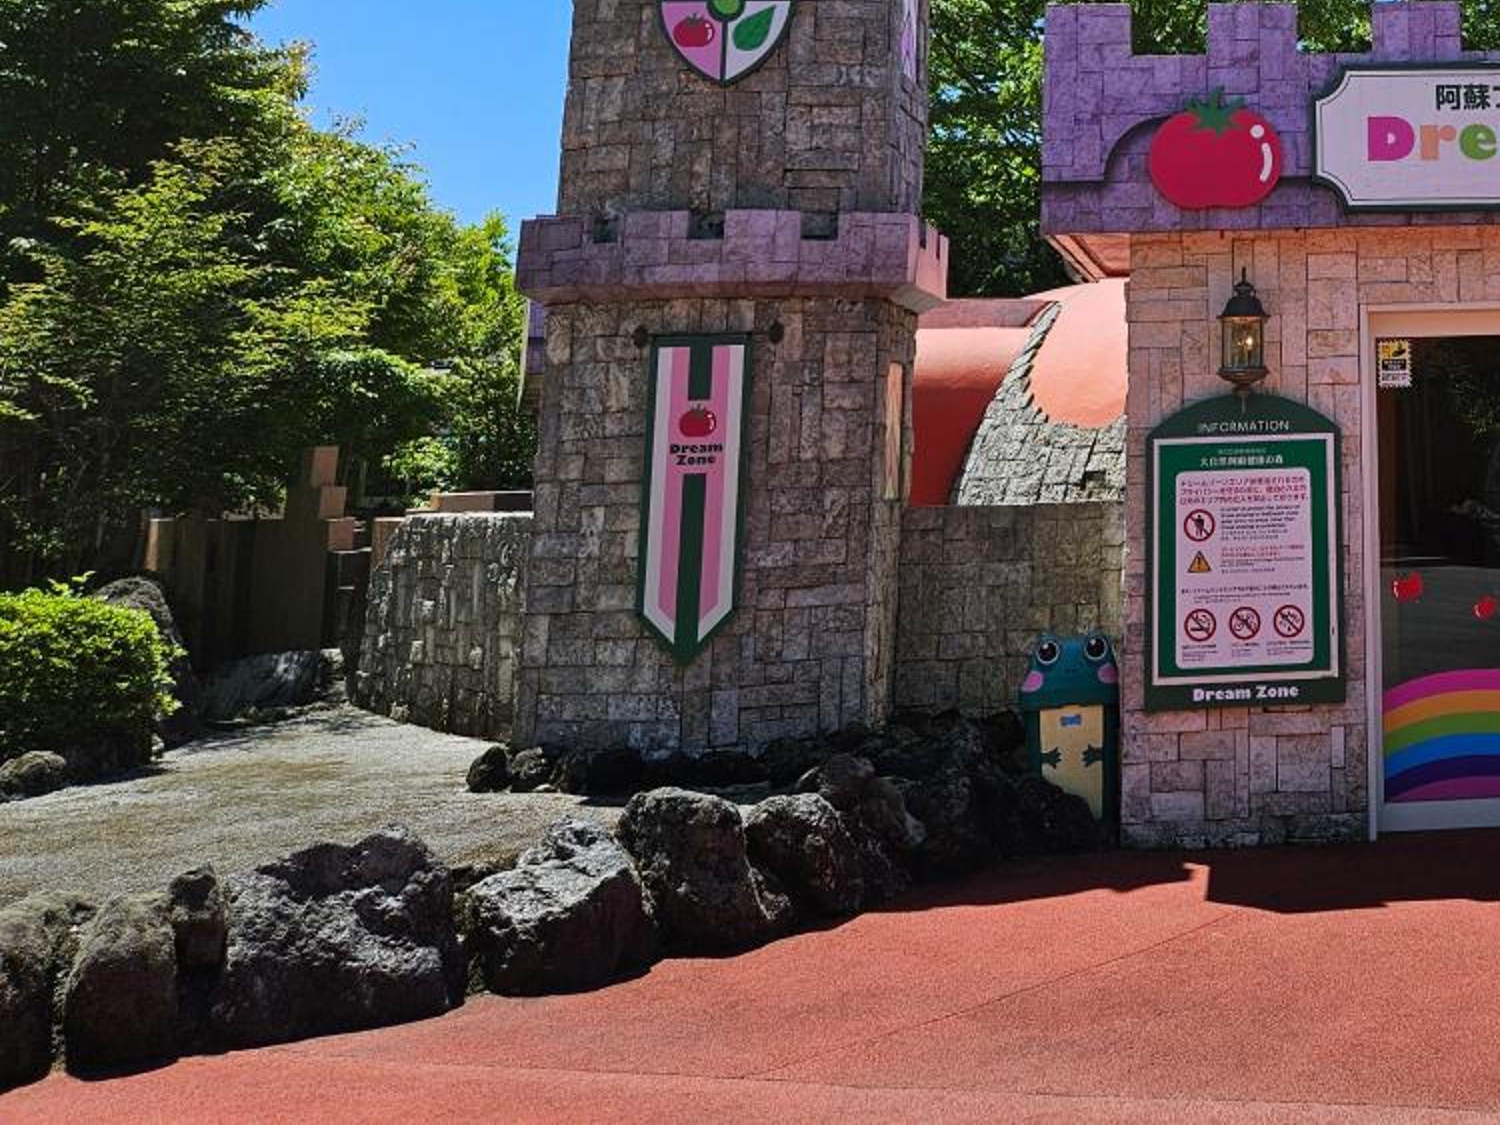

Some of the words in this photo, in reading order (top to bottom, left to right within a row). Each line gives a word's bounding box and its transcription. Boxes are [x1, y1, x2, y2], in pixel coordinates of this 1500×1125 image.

[1198, 420, 1290, 433] INFORMATION
[669, 443, 724, 455] Dream
[675, 455, 716, 466] Zone
[1192, 685, 1251, 703] Dream
[1255, 684, 1300, 700] Zone
